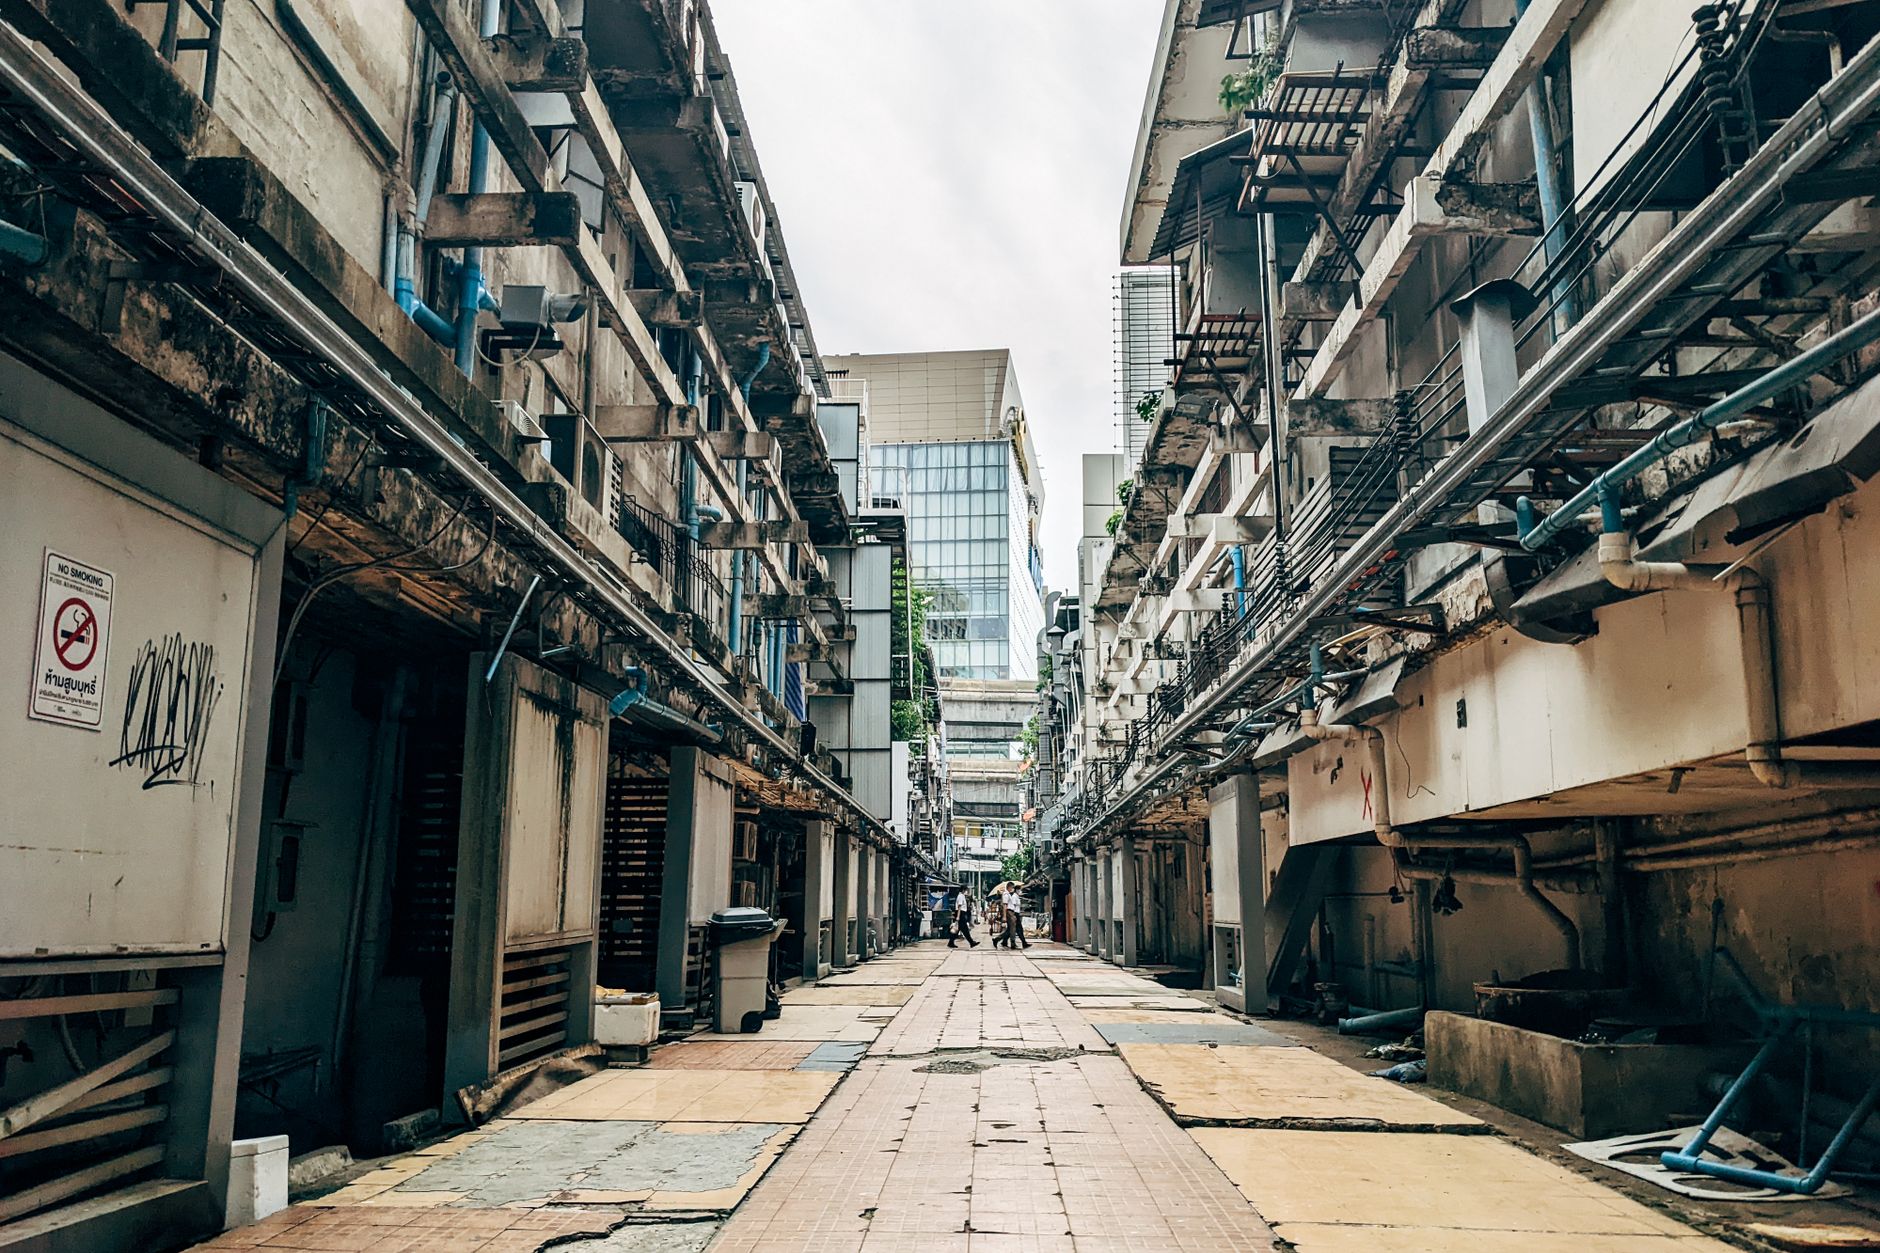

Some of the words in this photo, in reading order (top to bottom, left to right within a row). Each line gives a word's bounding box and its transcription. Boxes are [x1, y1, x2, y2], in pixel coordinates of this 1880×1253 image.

[58, 563, 69, 575] NO
[70, 568, 103, 587] SMOKING
[45, 668, 97, 698] ห้ามสูบบุหรี่
